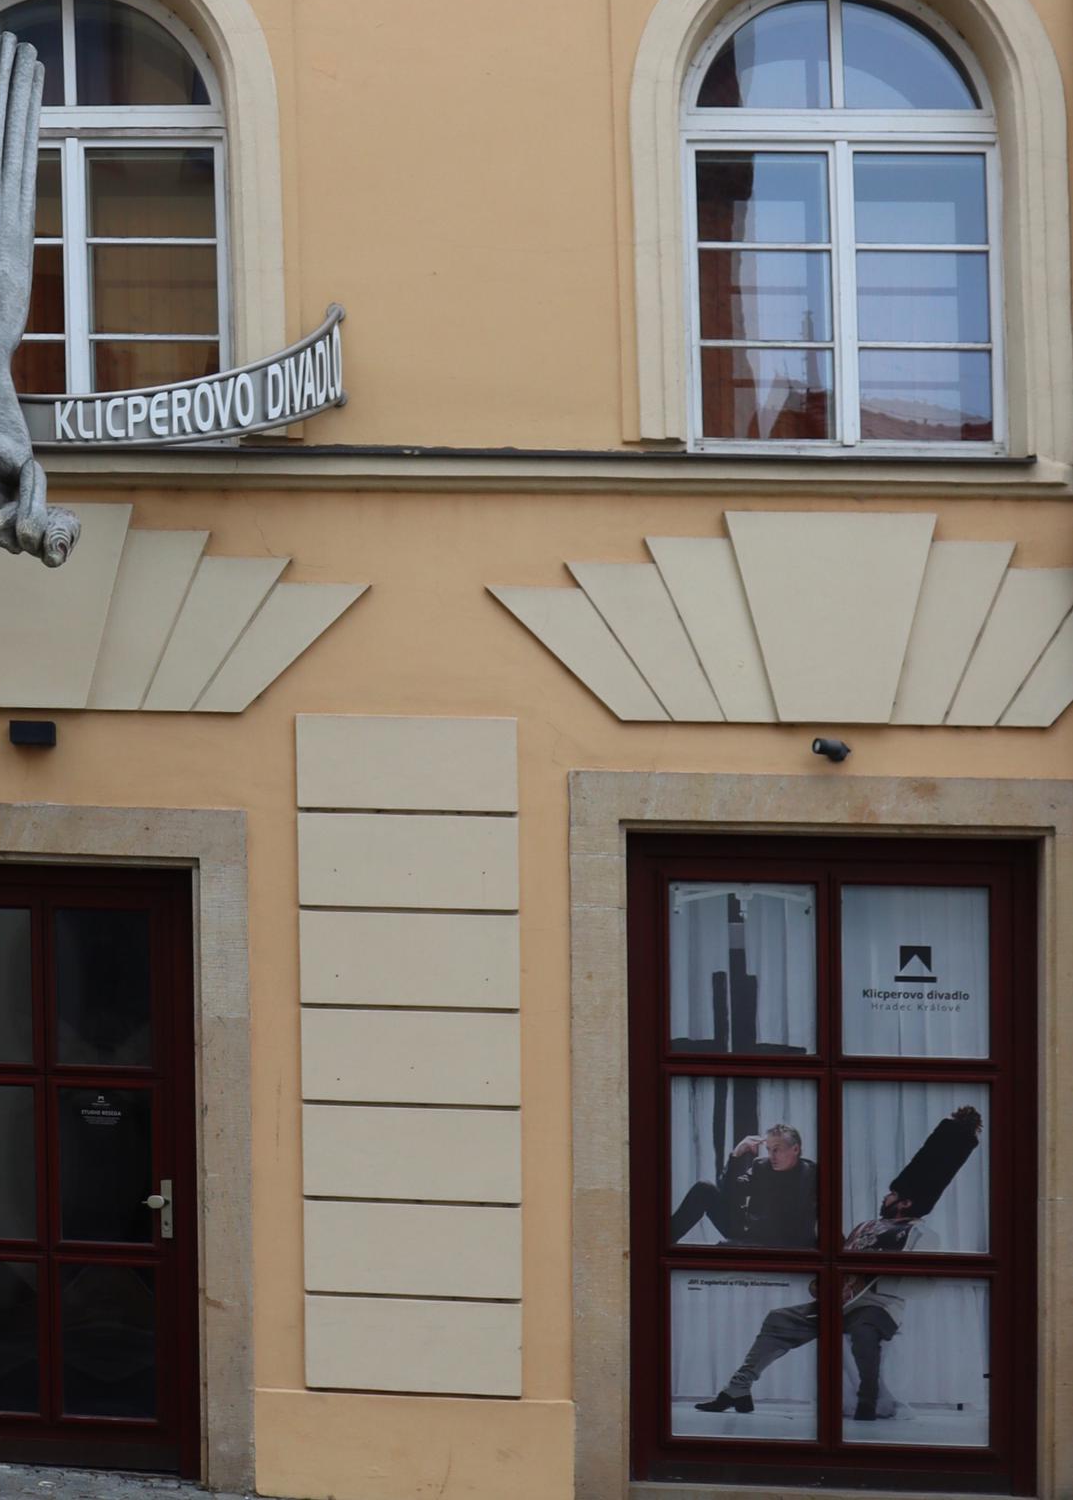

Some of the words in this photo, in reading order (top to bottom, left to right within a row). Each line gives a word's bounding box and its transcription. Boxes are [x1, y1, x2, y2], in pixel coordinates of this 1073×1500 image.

[55, 373, 254, 440] KLICPEROVO
[266, 325, 342, 420] DIVADLO
[862, 989, 924, 1000] Klicperovo
[926, 990, 970, 1001] divadlo
[871, 1003, 912, 1011] Hradec
[916, 1003, 961, 1012] Králové
